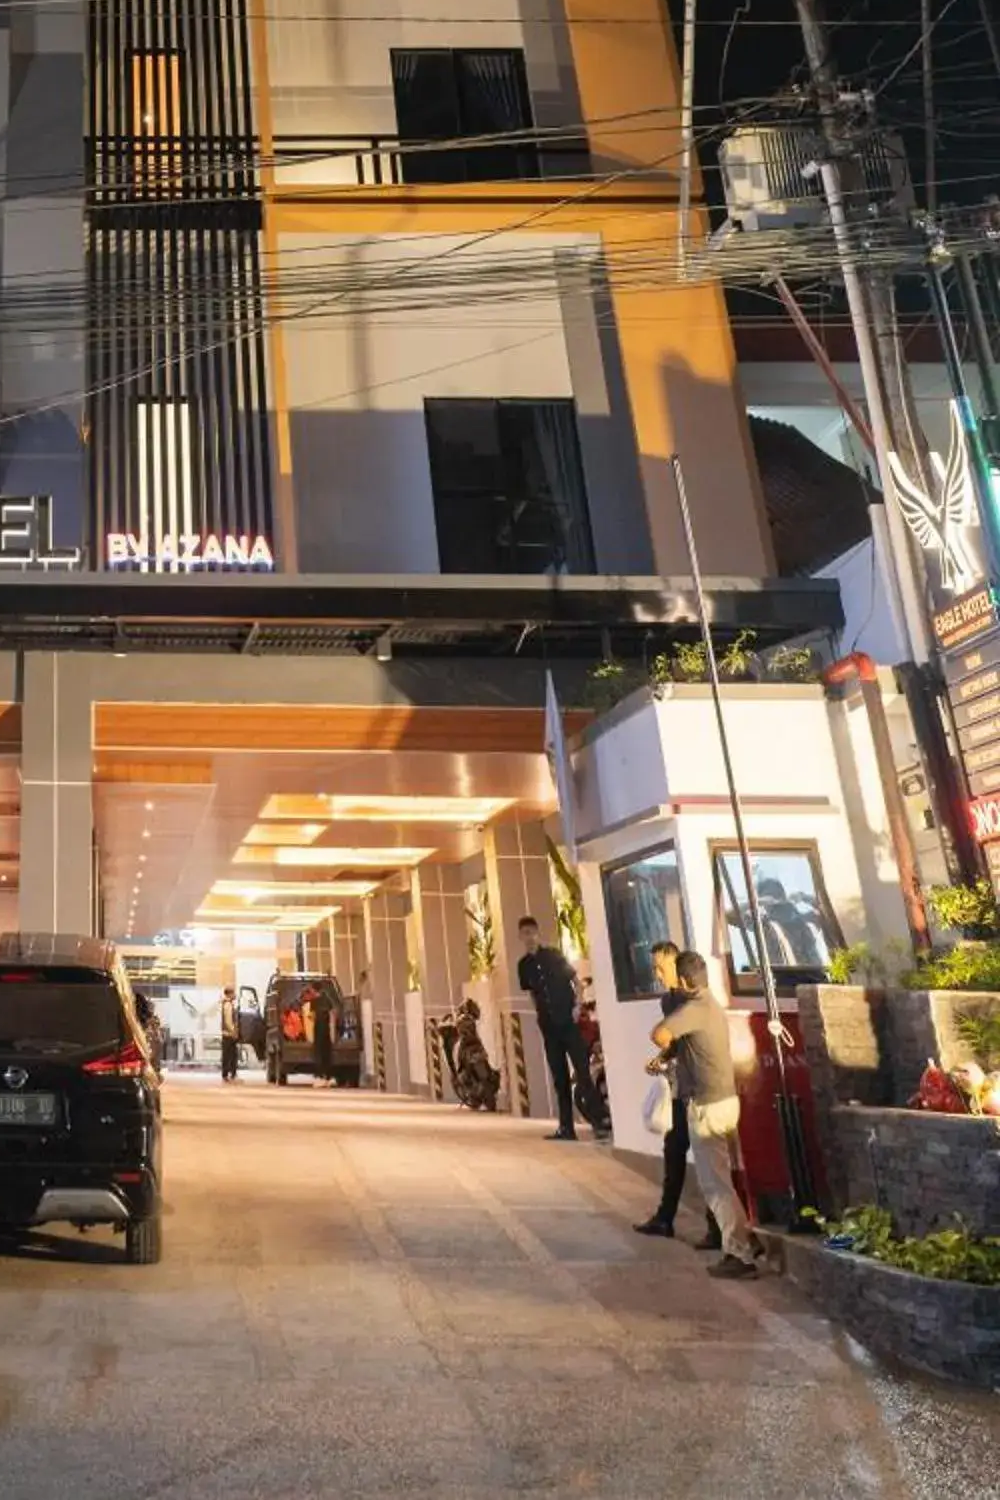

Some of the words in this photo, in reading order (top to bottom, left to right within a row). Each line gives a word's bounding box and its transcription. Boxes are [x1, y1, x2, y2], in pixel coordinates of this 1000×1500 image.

[107, 533, 149, 563] BY
[157, 534, 273, 565] AZANA
[934, 605, 963, 636] EAGLE
[960, 591, 993, 622] HOTEL
